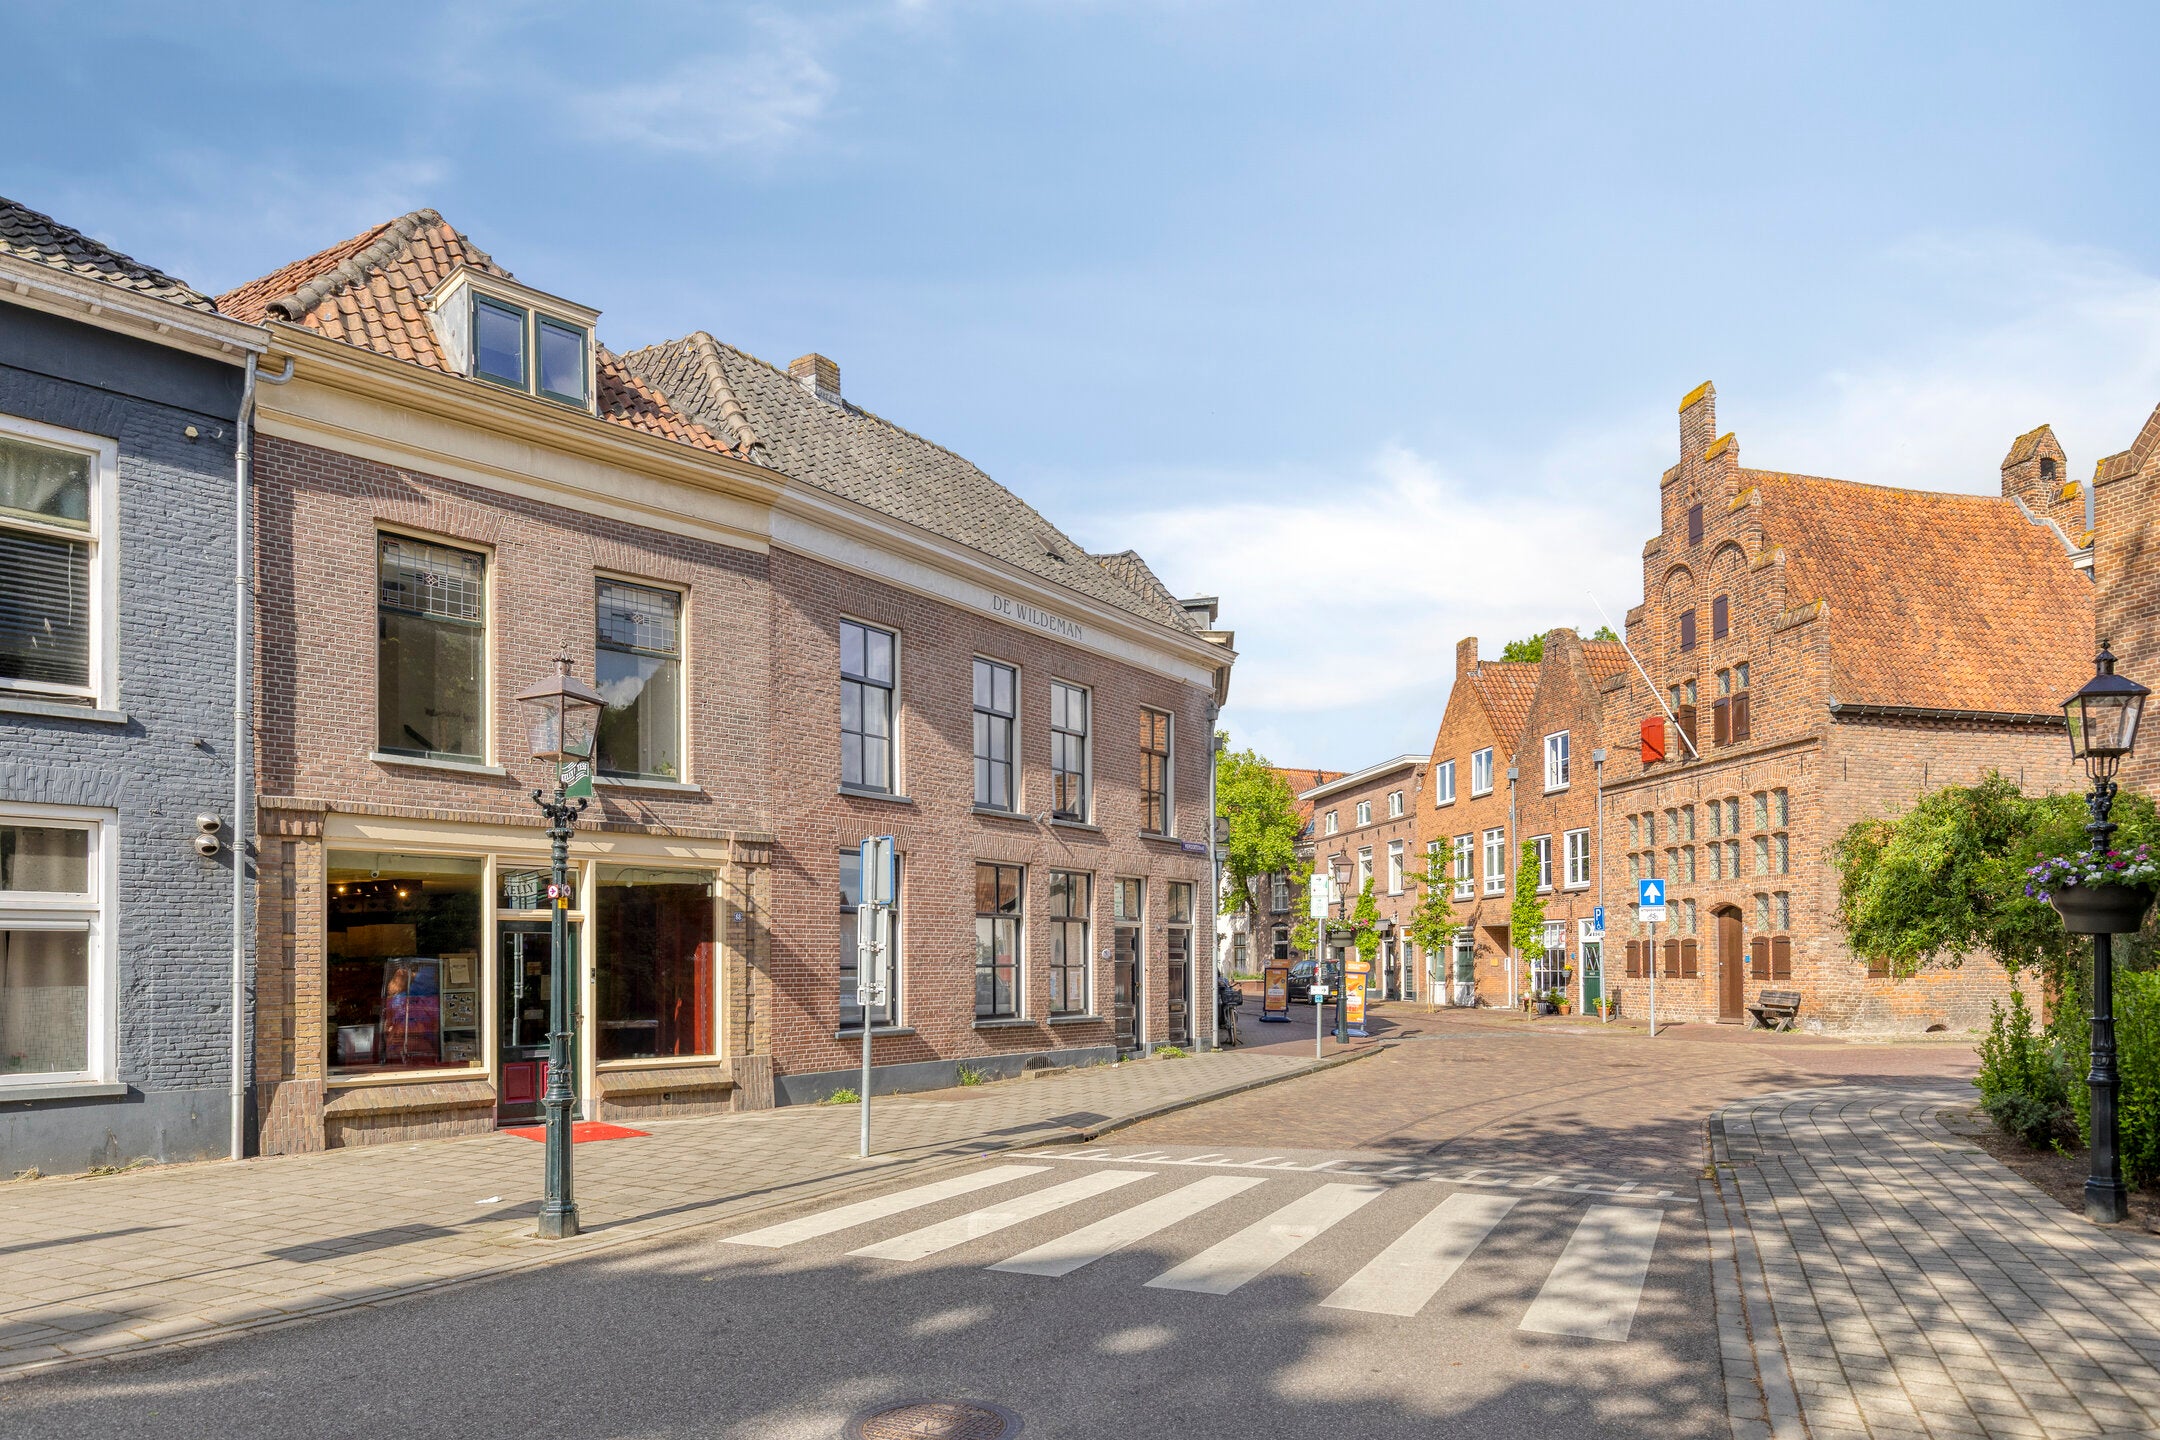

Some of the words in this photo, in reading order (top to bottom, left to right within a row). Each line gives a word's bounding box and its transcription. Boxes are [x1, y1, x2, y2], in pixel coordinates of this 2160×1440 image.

[993, 595, 1011, 615] DE
[1016, 603, 1083, 640] WILDEMAN
[1595, 908, 1602, 921] P
